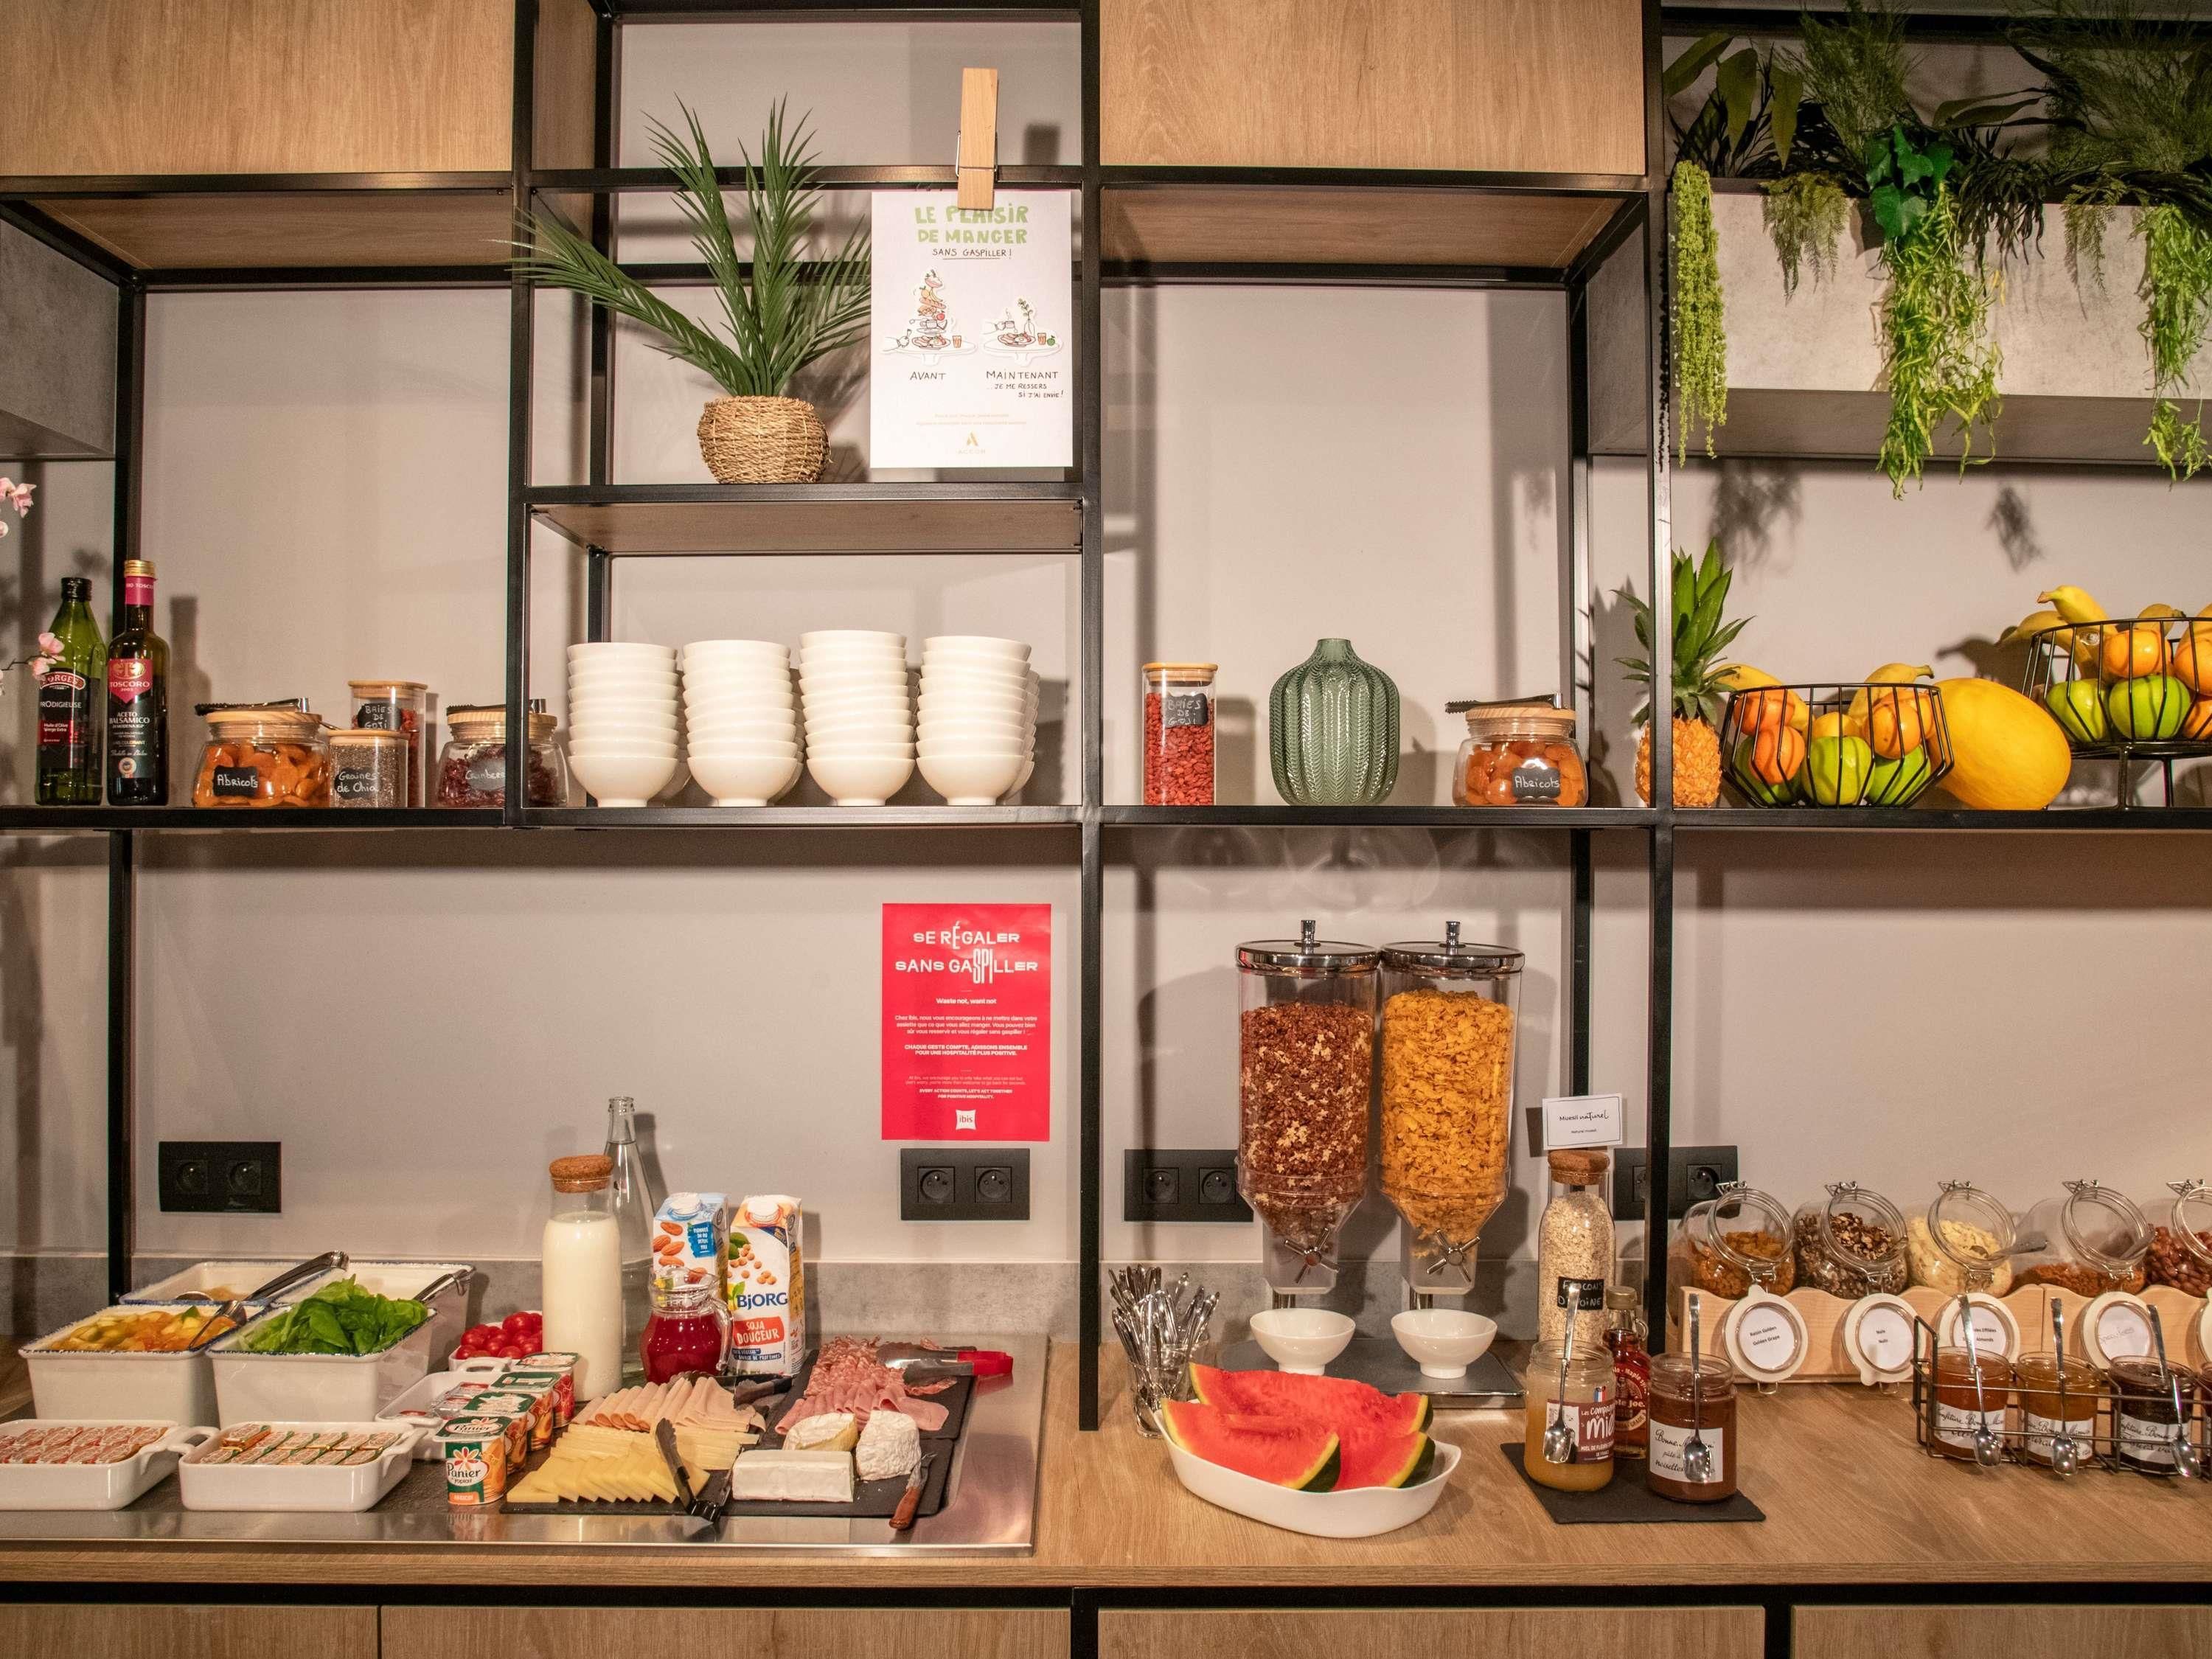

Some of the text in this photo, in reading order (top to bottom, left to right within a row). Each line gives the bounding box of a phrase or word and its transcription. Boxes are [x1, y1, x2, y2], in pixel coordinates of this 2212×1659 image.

[914, 206, 936, 224] LE
[918, 229, 1028, 244] DE MANGER
[932, 248, 958, 257] SANS
[909, 370, 947, 380] AVANT
[985, 369, 1059, 380] MAINTENANT
[372, 713, 384, 721] DE
[336, 782, 350, 793] de
[913, 920, 1020, 950] SE RÉGALER
[894, 947, 1039, 984] SANS GASPILLER
[959, 1114, 973, 1124] ibis
[1579, 1109, 1610, 1121] naturel
[1562, 1279, 1603, 1291] FCONS
[745, 1321, 765, 1331] SOJA
[736, 1327, 780, 1345] DOUCEUR
[447, 1462, 481, 1478] Panier
